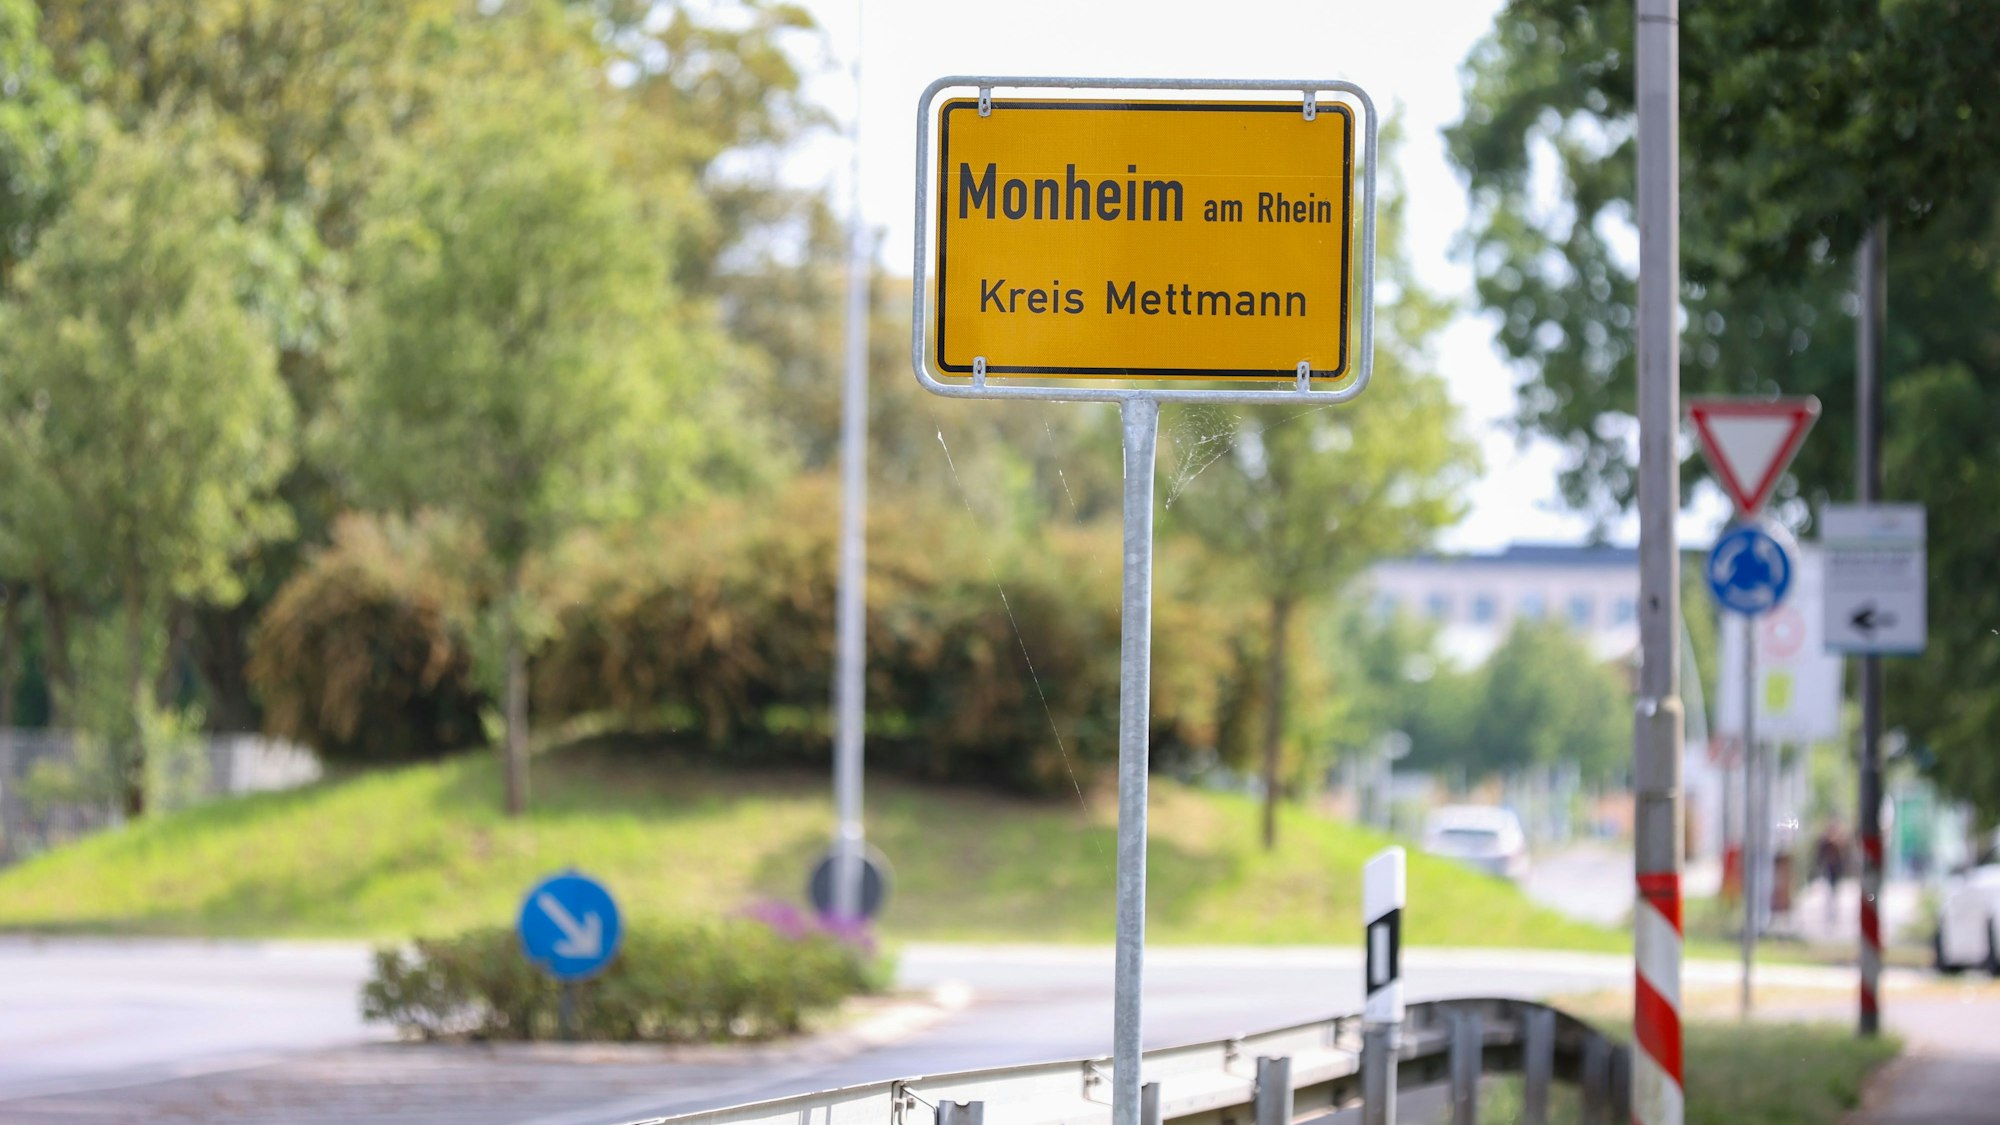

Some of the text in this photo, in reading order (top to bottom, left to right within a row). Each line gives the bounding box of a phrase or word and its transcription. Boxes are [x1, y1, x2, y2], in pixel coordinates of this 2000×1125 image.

[958, 162, 1332, 224] Monheim am Rhein
[979, 279, 1306, 317] Kreis Mettmann
